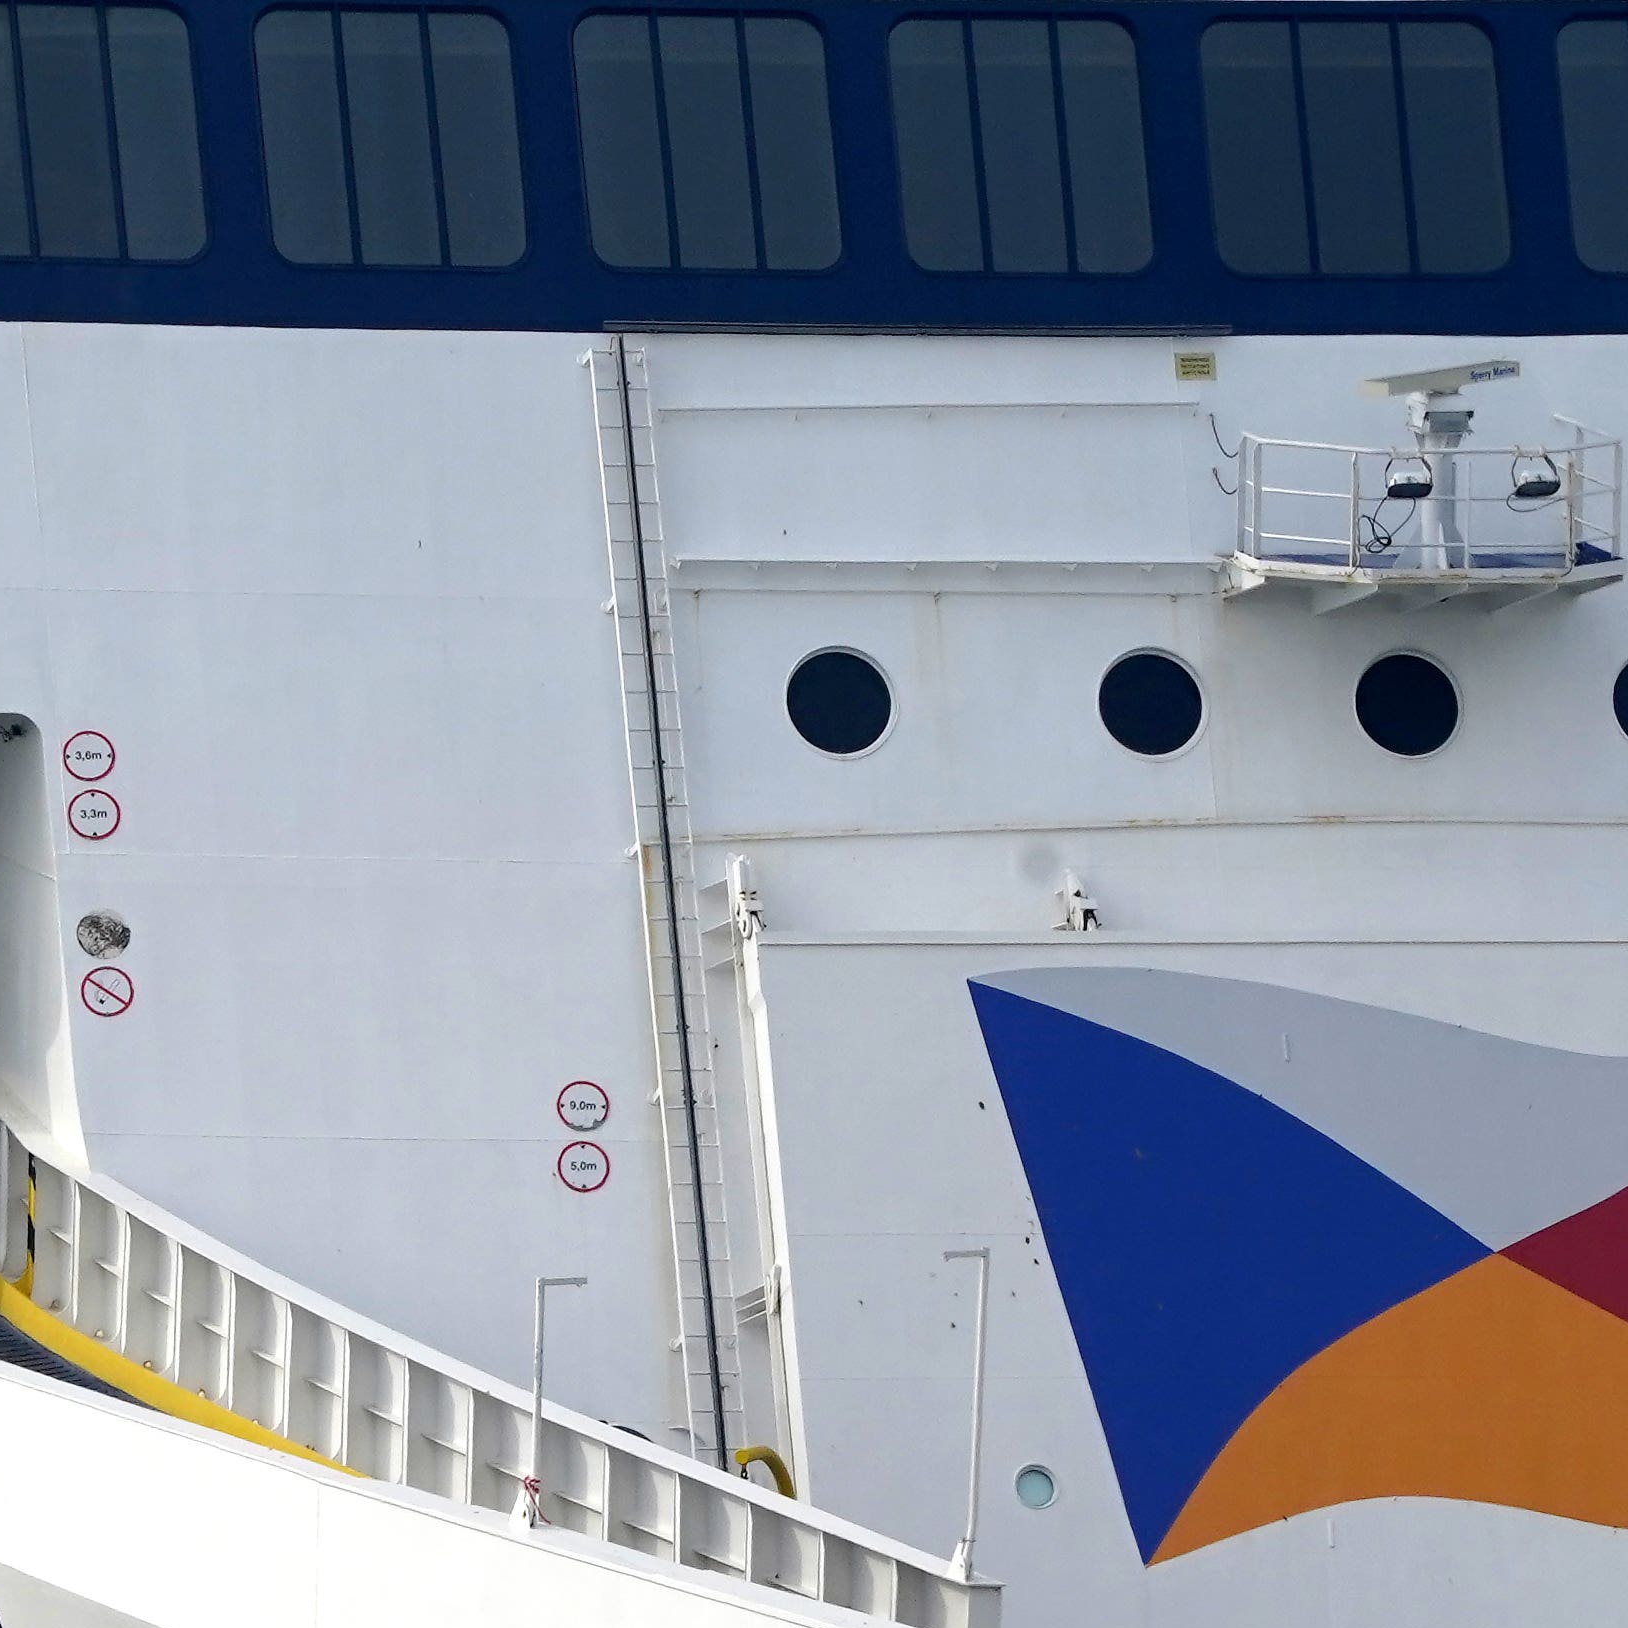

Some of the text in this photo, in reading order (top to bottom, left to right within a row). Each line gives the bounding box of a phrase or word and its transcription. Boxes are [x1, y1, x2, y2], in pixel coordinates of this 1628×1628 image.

[75, 750, 102, 762] 3,6m
[80, 808, 108, 820] 3,3m
[570, 1161, 597, 1171] 5,0m
